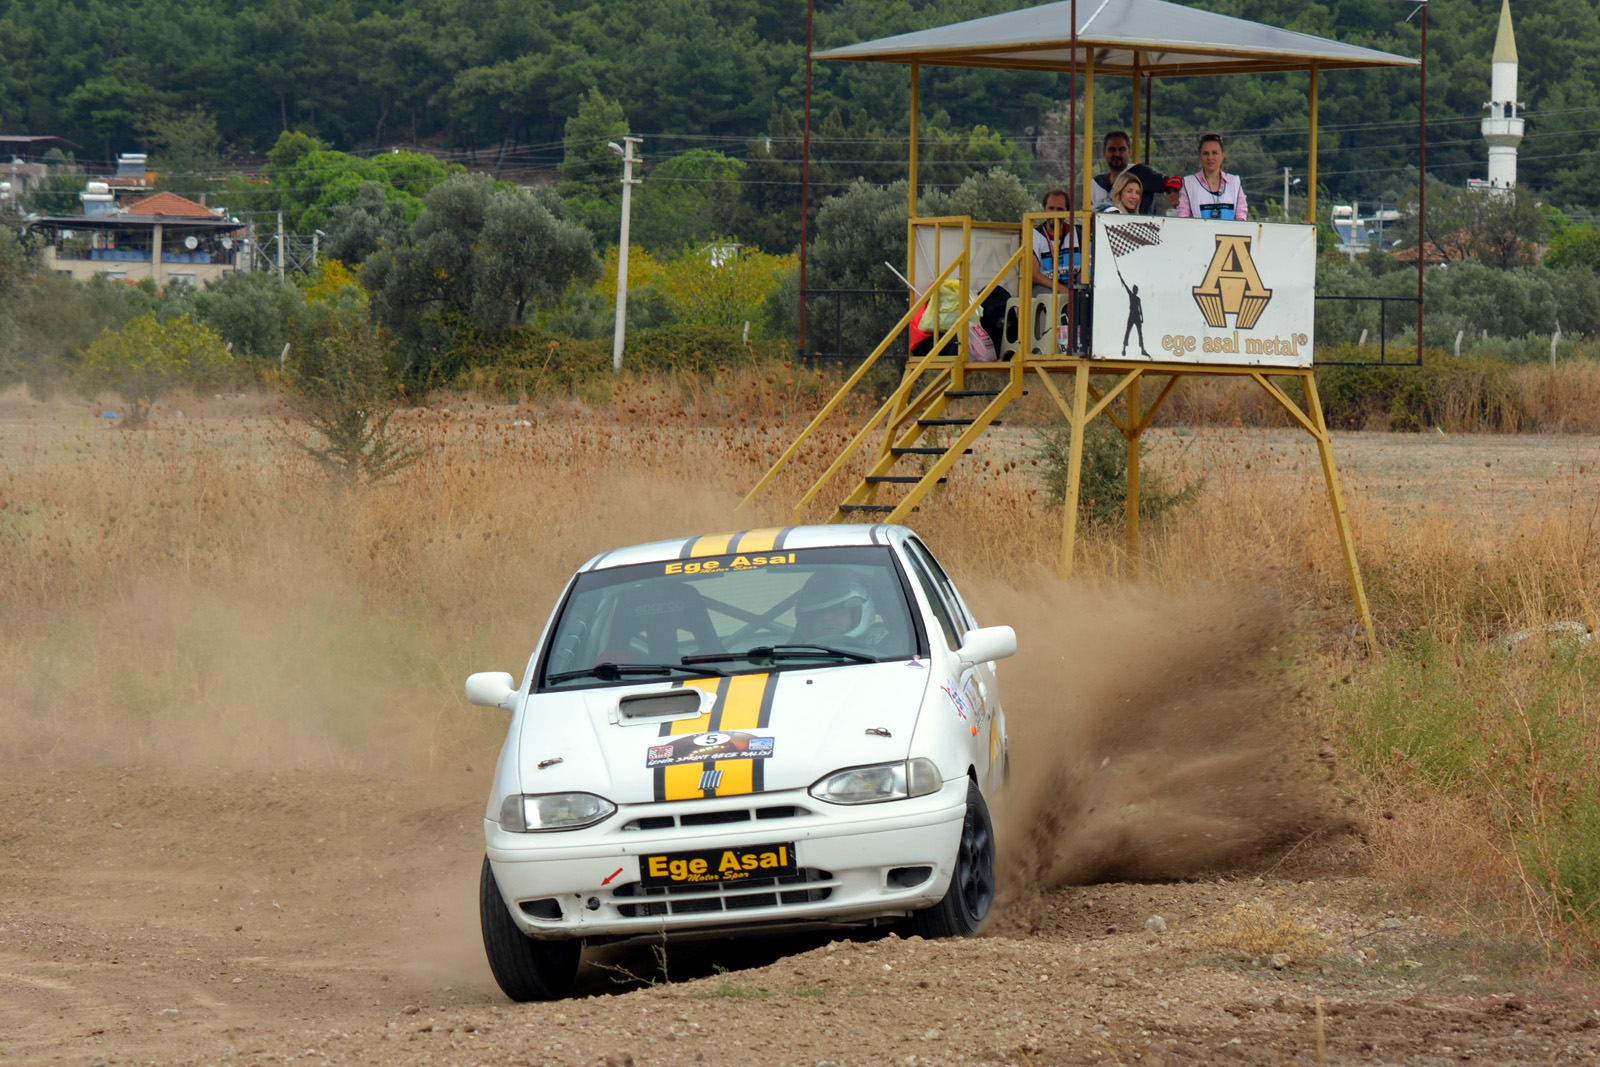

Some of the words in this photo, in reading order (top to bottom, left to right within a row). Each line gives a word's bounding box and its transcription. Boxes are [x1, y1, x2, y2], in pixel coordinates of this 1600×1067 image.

[1162, 334, 1196, 357] ege
[1202, 330, 1240, 354] asal
[665, 560, 720, 575] Ege
[730, 553, 796, 568] Asal
[705, 734, 718, 744] 5
[711, 751, 738, 760] GECE
[648, 856, 708, 881] Ege
[718, 846, 788, 872] Asal
[687, 873, 720, 882] Motor
[723, 870, 750, 881] Spor
